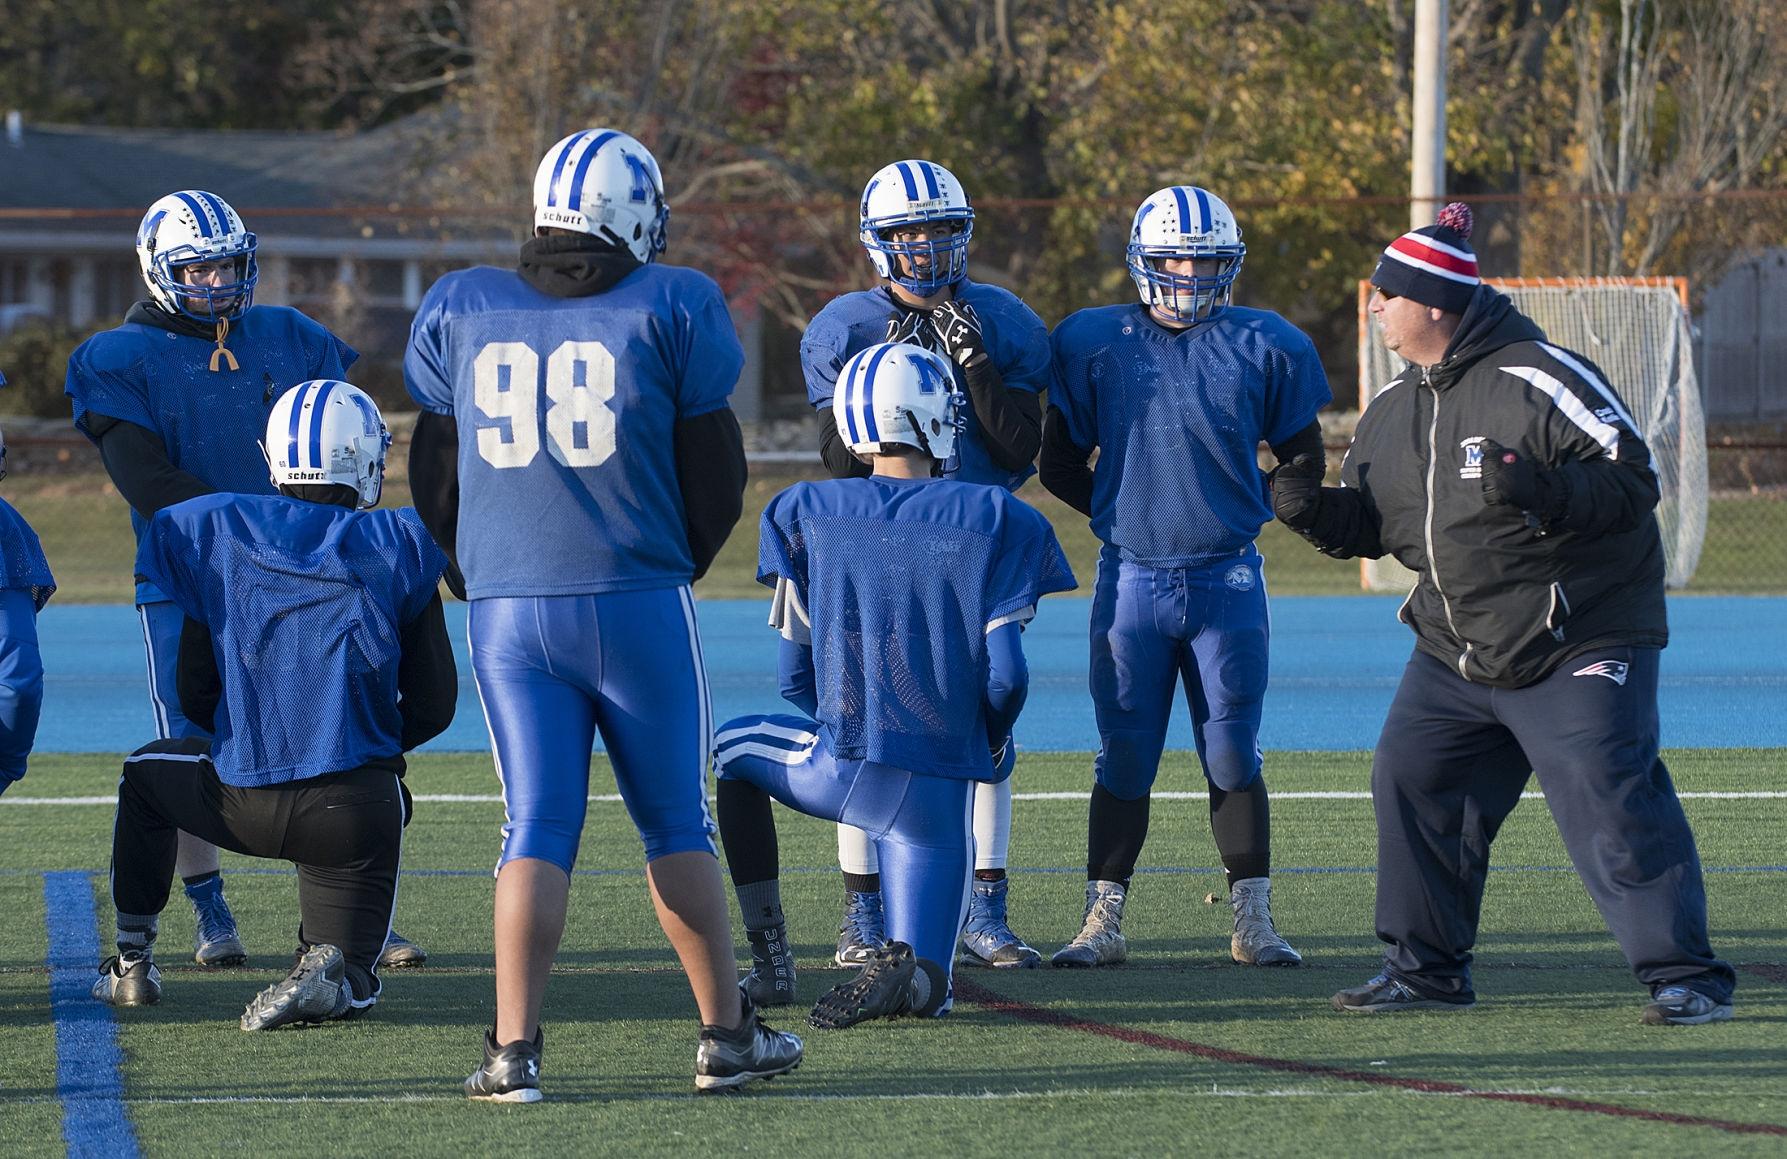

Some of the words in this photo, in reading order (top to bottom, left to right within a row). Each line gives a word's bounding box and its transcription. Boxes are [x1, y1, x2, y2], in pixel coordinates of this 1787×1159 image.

[542, 211, 582, 225] schutt
[474, 341, 616, 468] 98
[764, 929, 787, 990] UNDER
